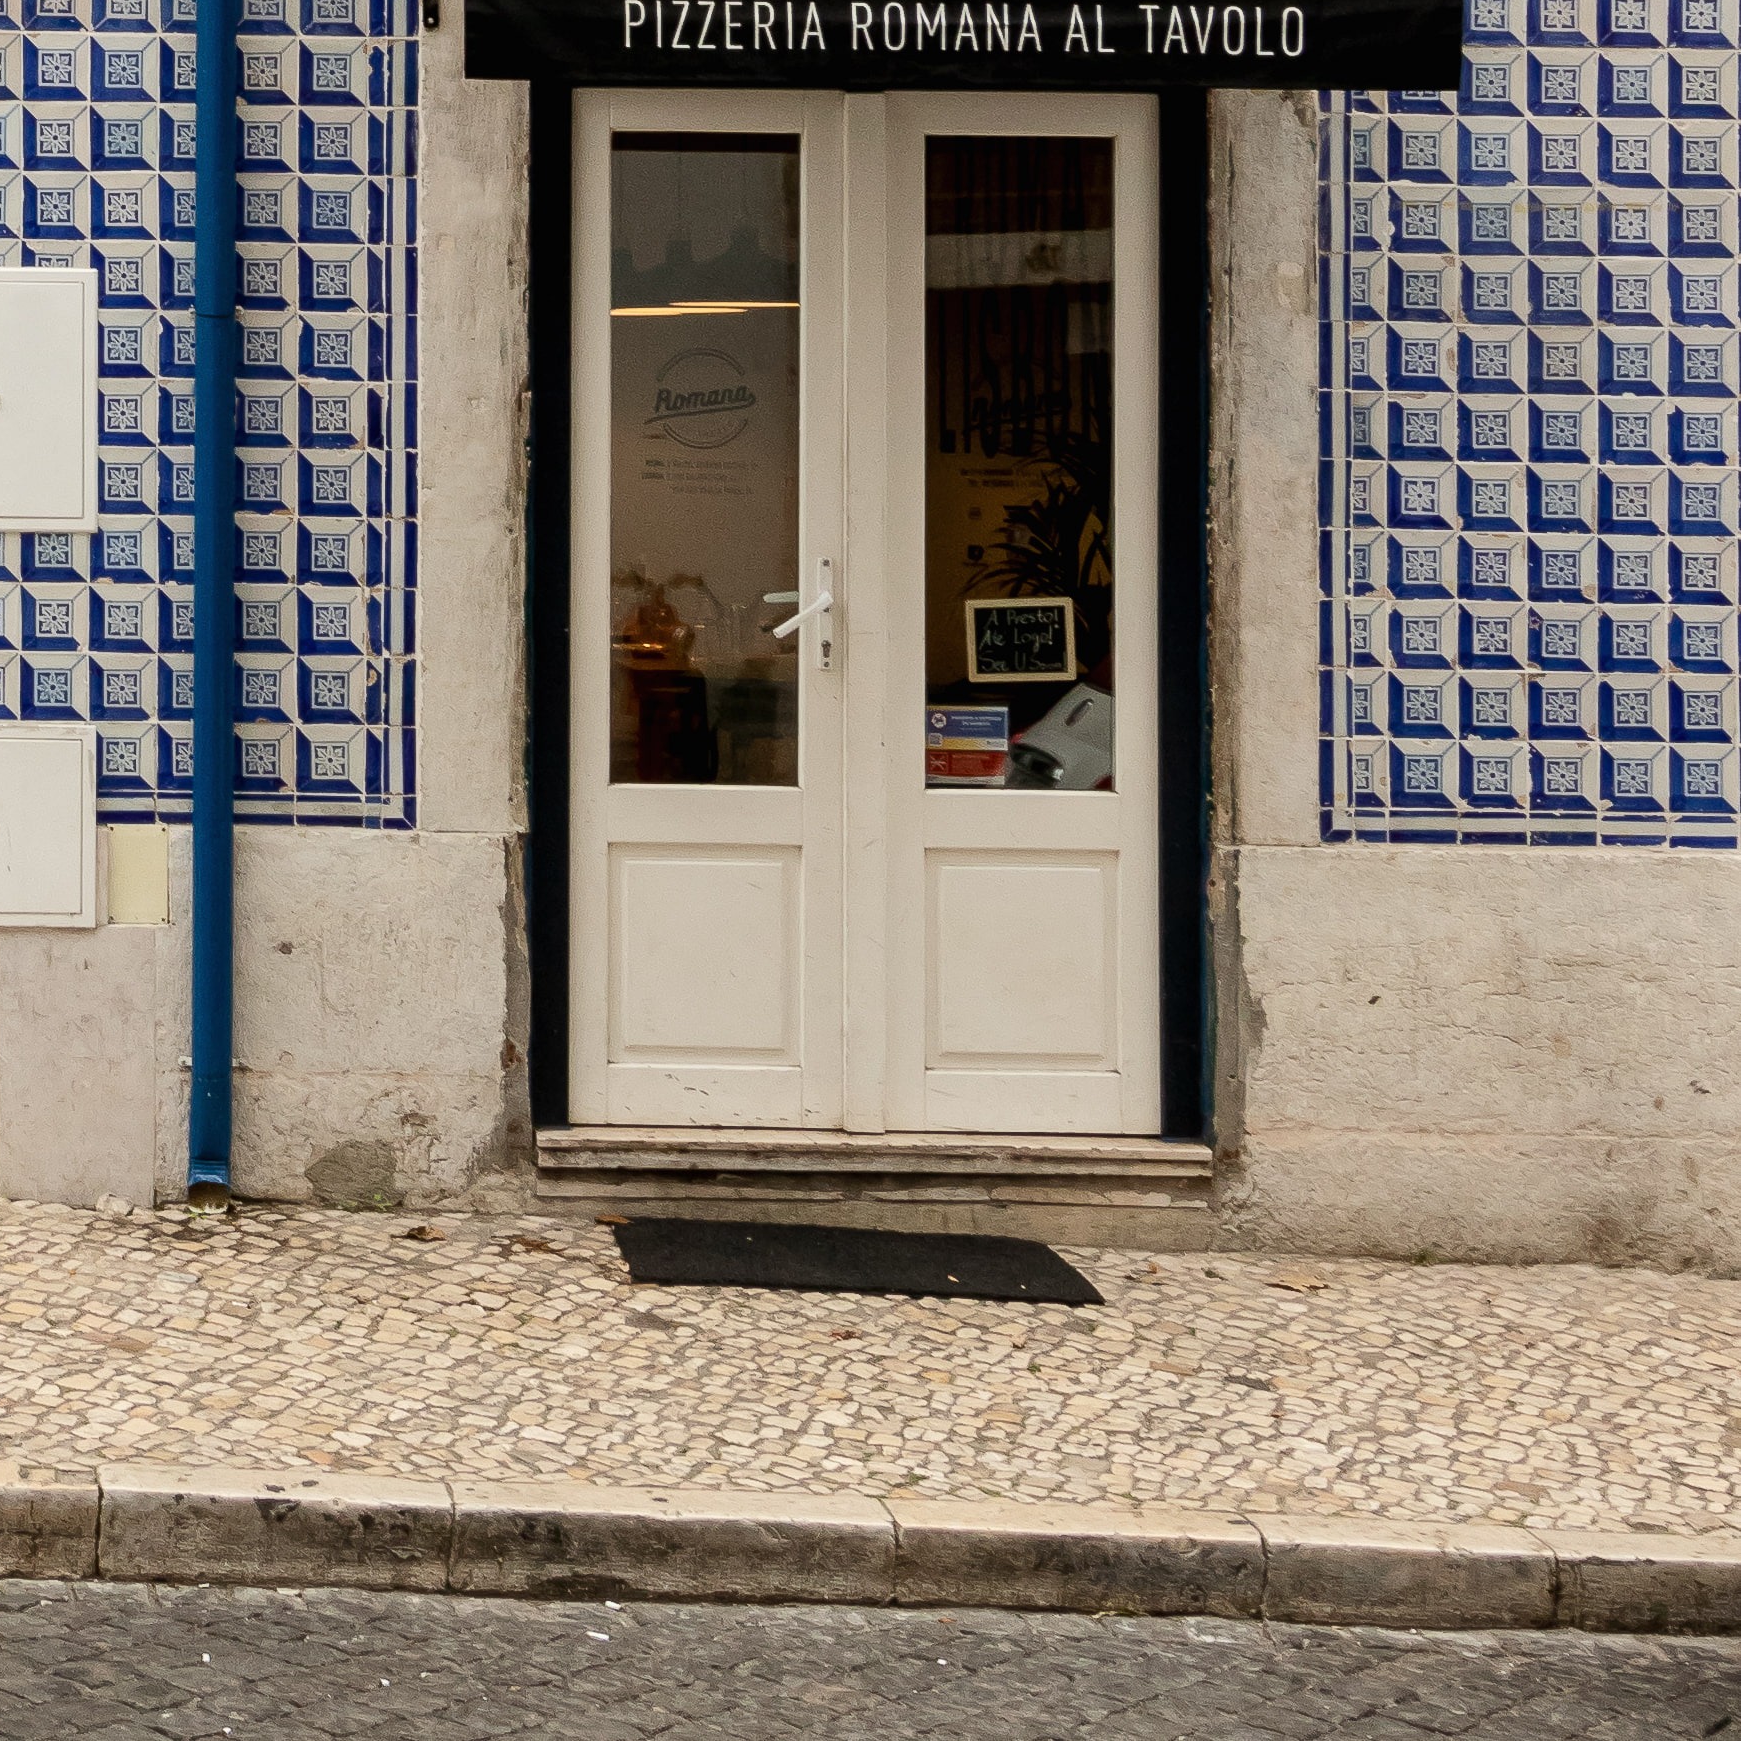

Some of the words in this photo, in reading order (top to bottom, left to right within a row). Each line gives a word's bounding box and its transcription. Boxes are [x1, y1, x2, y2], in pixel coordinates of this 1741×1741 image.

[624, 0, 826, 51] PIZZERIA
[850, 1, 1043, 54] ROMANA
[1064, 4, 1116, 55] AL
[1138, 5, 1305, 58] TAVOLO
[655, 385, 753, 413] Romana
